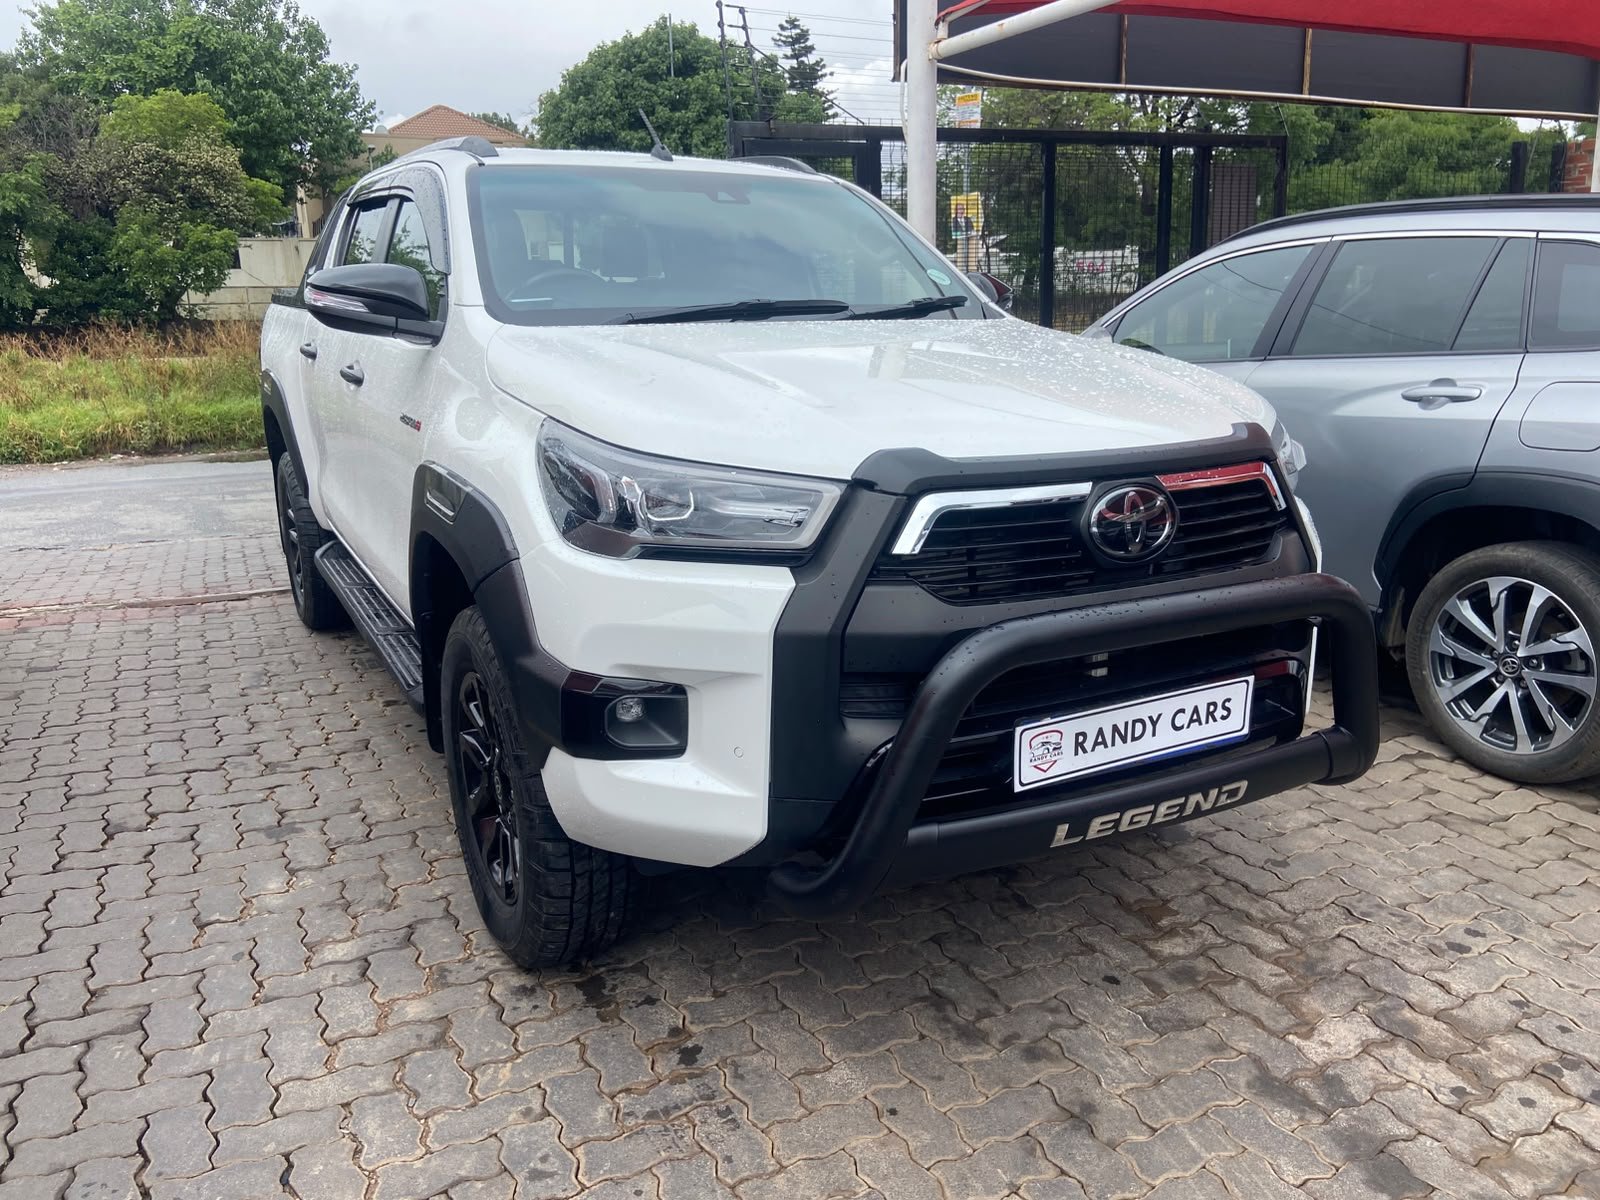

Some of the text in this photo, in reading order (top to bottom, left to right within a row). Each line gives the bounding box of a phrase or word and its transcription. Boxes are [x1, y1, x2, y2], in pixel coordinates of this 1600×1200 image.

[1074, 698, 1232, 756] RANDY CARS
[1029, 754, 1048, 762] RANDY
[1050, 780, 1248, 847] LEGEND
